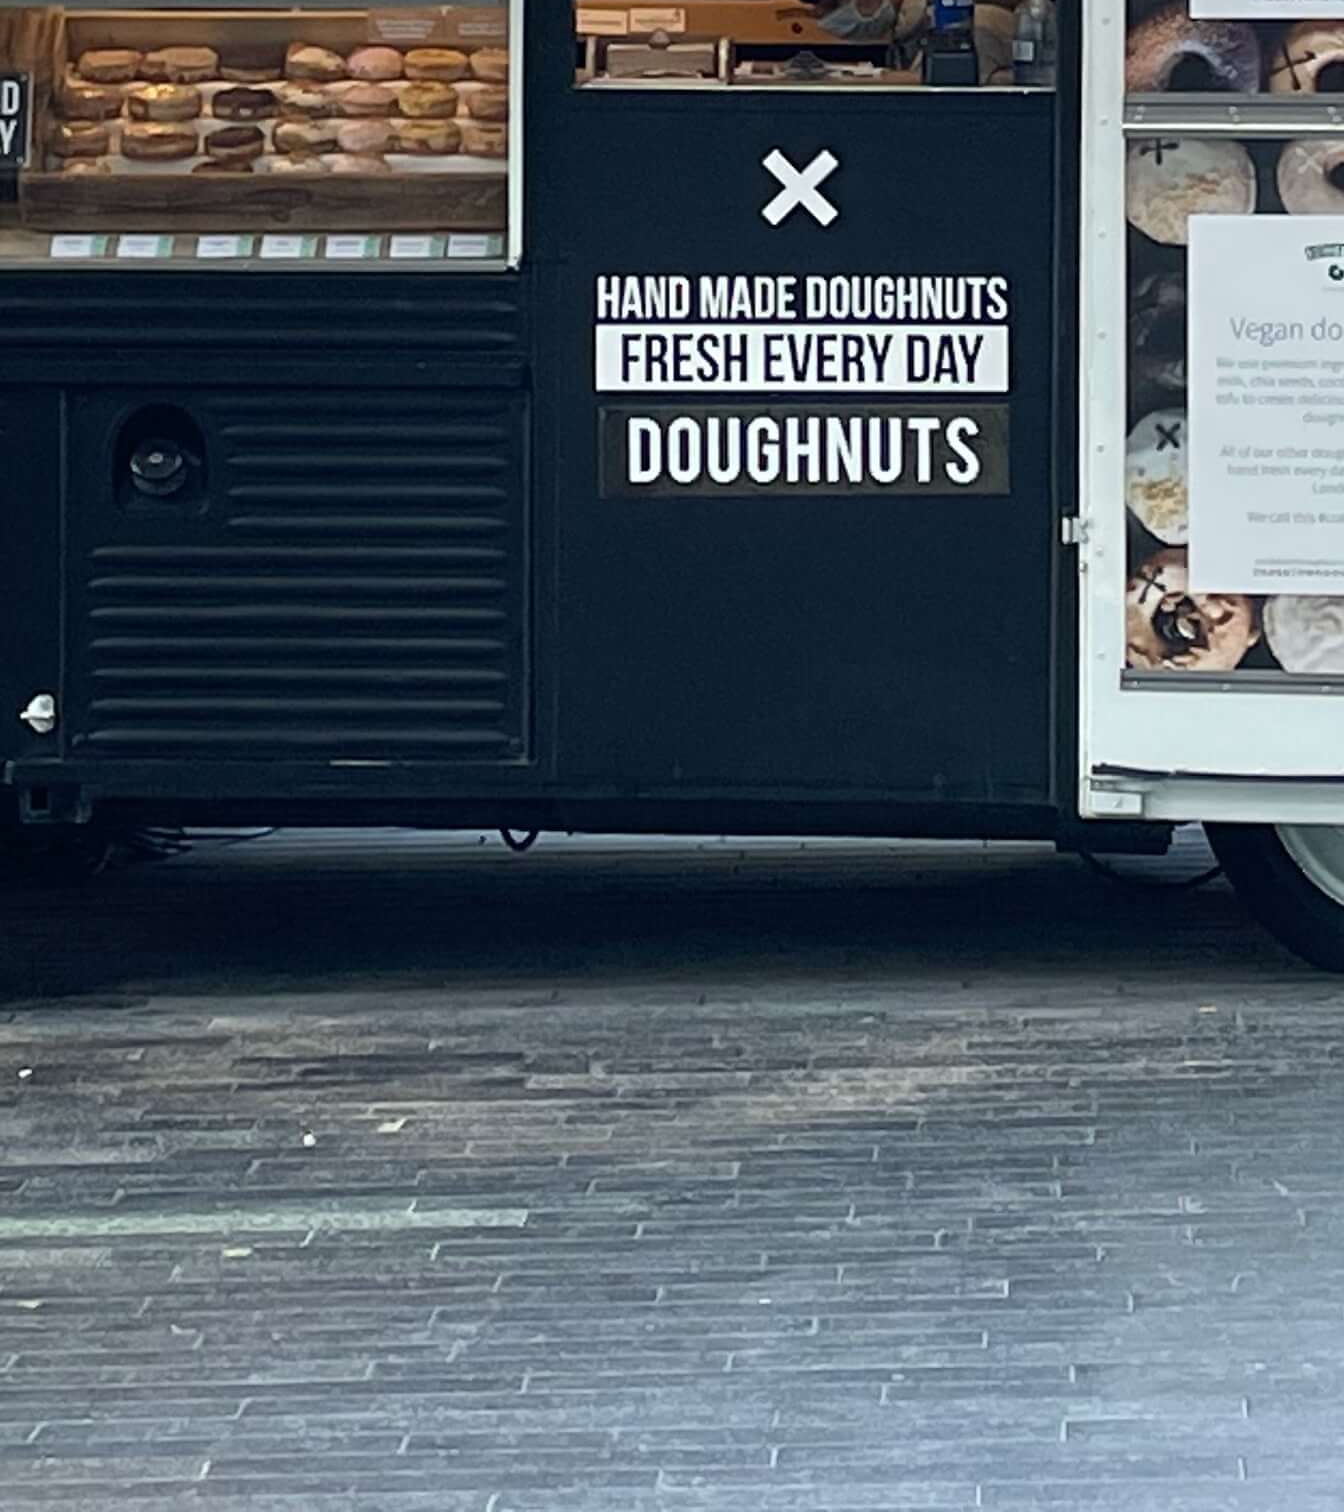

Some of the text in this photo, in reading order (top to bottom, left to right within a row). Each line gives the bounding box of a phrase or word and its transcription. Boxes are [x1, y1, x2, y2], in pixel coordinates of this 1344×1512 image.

[597, 276, 1009, 320] HAND MADE DOUGHNUTS
[1230, 317, 1304, 347] Vegan
[621, 333, 984, 383] FRESH EVERY DAY
[627, 416, 981, 484] DOUGHNUTS
